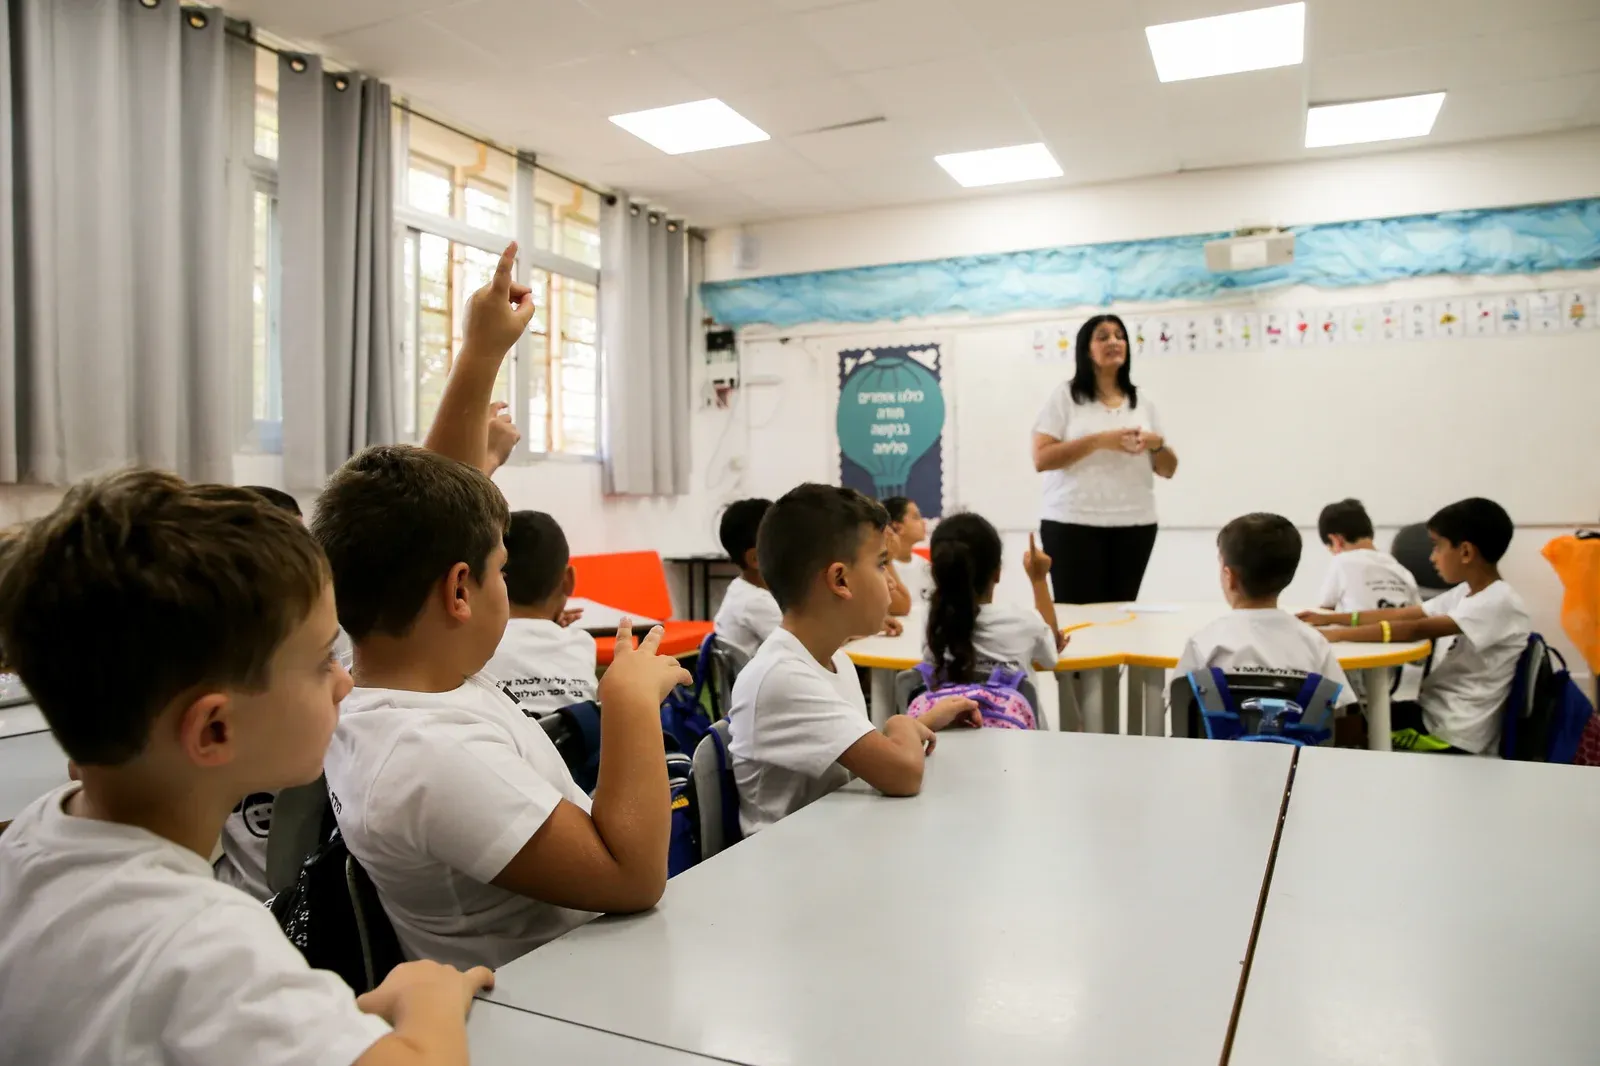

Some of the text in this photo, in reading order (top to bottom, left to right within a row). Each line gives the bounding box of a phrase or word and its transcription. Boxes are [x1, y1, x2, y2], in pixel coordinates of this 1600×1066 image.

[898, 389, 924, 402] כולנו
[877, 407, 904, 419] תודה
[871, 423, 910, 438] בבקשה
[873, 440, 908, 454] סליחה
[515, 676, 541, 686] לכתה
[547, 688, 566, 696] ספר
